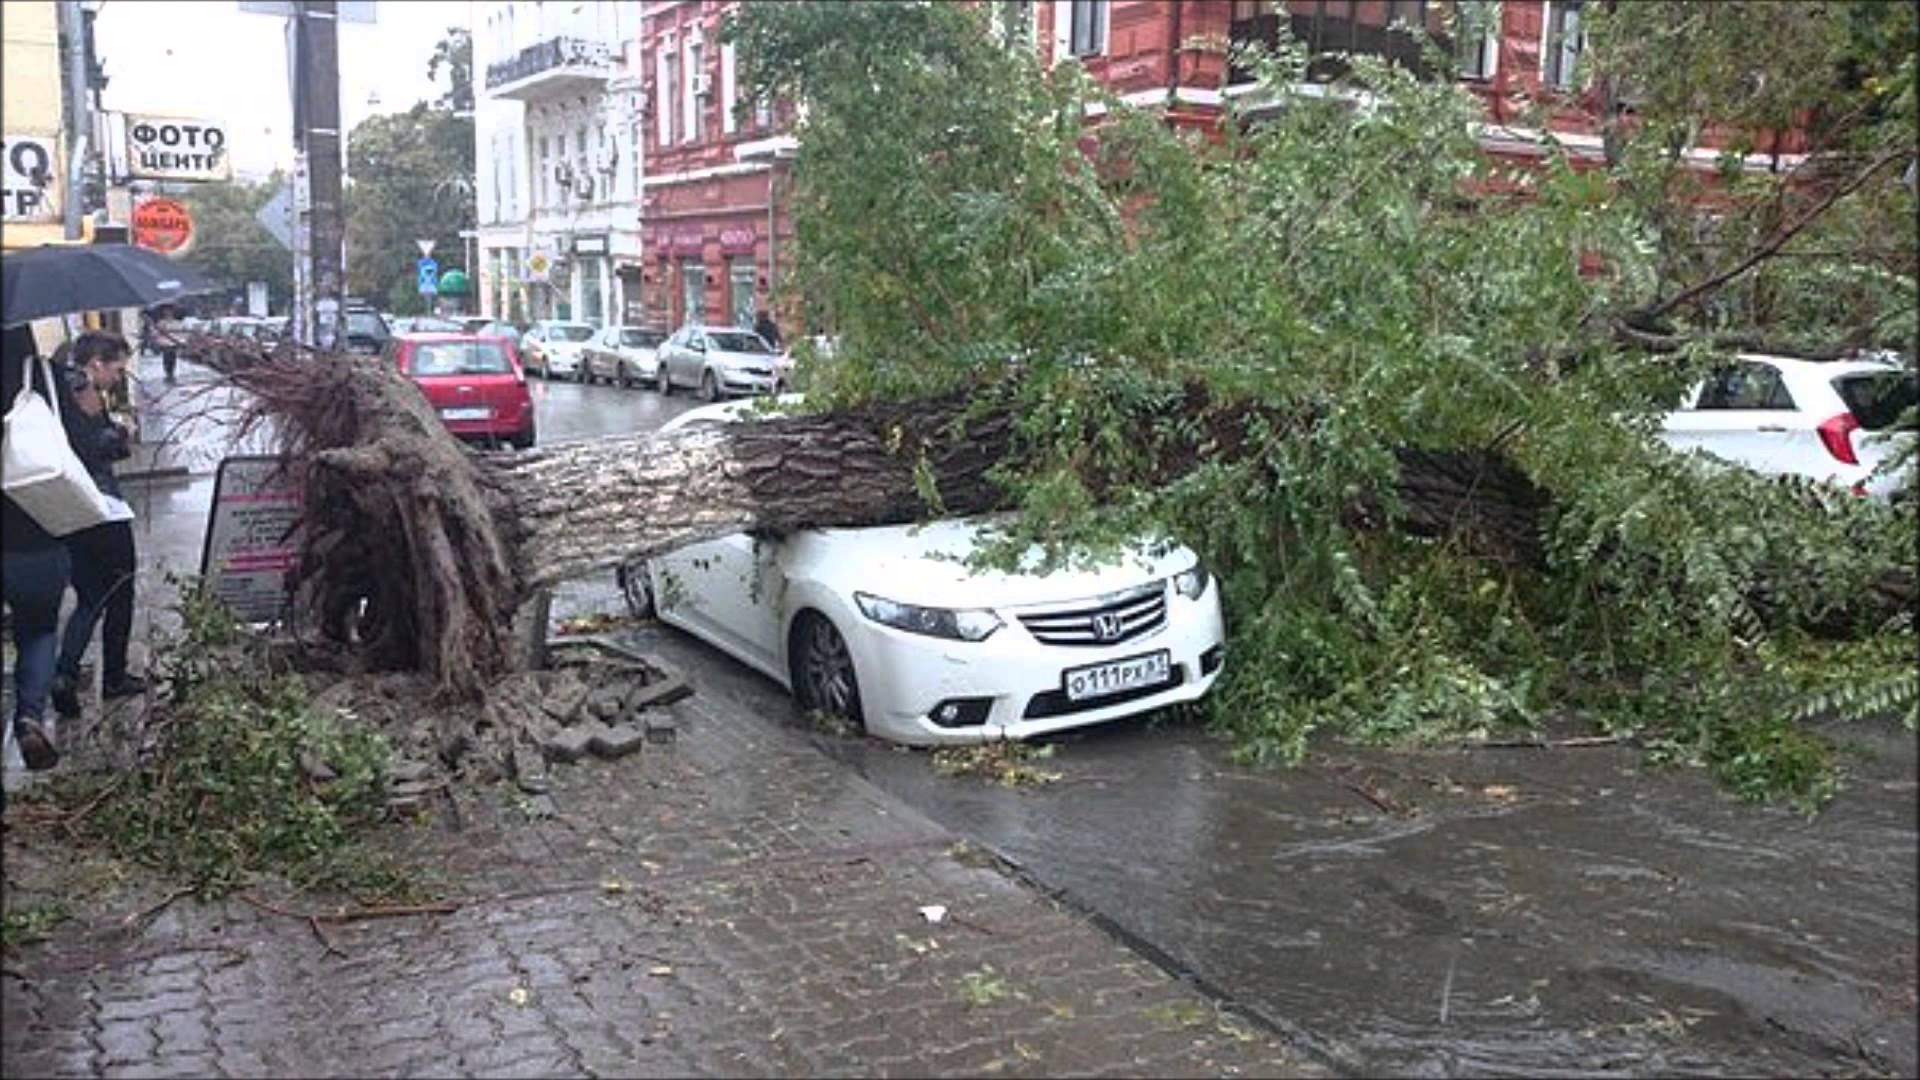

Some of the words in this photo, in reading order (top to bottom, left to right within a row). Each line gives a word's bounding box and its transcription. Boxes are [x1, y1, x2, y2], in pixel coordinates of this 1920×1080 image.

[133, 124, 225, 153] ФОТО
[1, 140, 50, 180] О
[140, 151, 220, 171] ЦЕНТР
